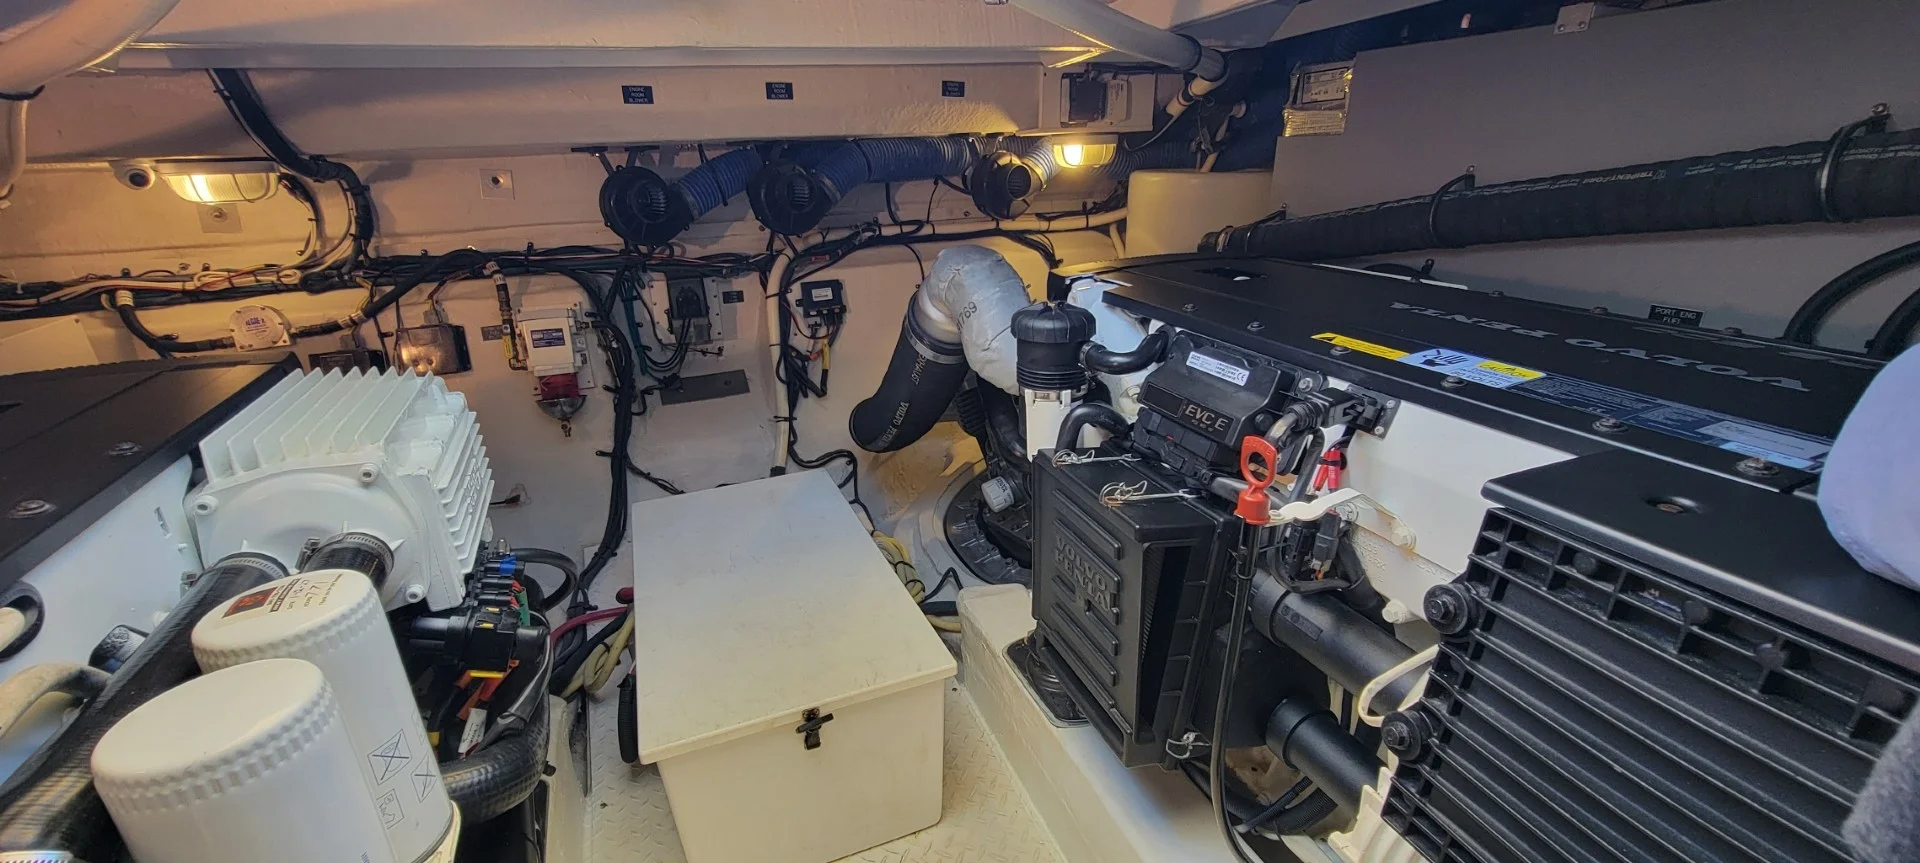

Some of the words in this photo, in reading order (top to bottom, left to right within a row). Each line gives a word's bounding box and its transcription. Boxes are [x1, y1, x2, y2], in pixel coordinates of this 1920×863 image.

[1390, 301, 1559, 338] PENTA
[1655, 307, 1676, 316] PORT
[1680, 311, 1697, 320] ENG
[1564, 337, 1813, 392] VOLVO
[894, 401, 909, 426] VOLVO
[1185, 404, 1215, 425] EVC
[1214, 417, 1229, 431] E
[1054, 548, 1112, 612] PENTA
[1055, 534, 1107, 591] VOLVO
